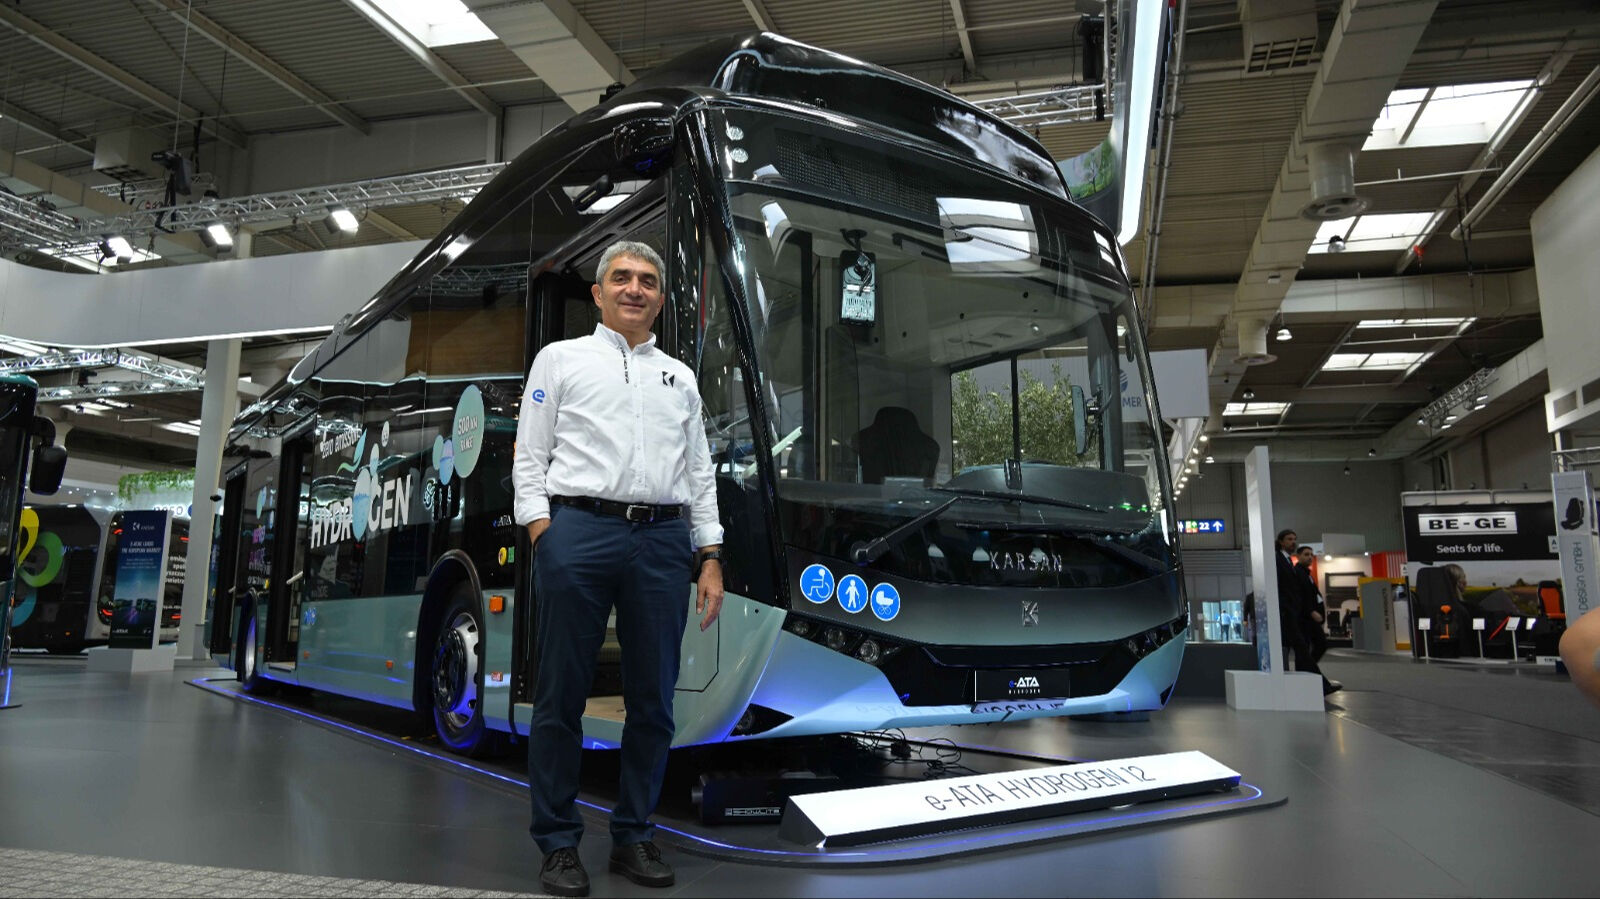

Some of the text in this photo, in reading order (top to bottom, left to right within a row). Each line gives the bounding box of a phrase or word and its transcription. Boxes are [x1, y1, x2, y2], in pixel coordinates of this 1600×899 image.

[458, 415, 470, 435] 500
[310, 471, 411, 549] HYDROGEN
[1199, 522, 1210, 530] 22
[1436, 543, 1504, 553] Seats for life.
[989, 550, 1063, 573] KARSAN
[925, 765, 1156, 811] e-ATA HYDROGEN 12
